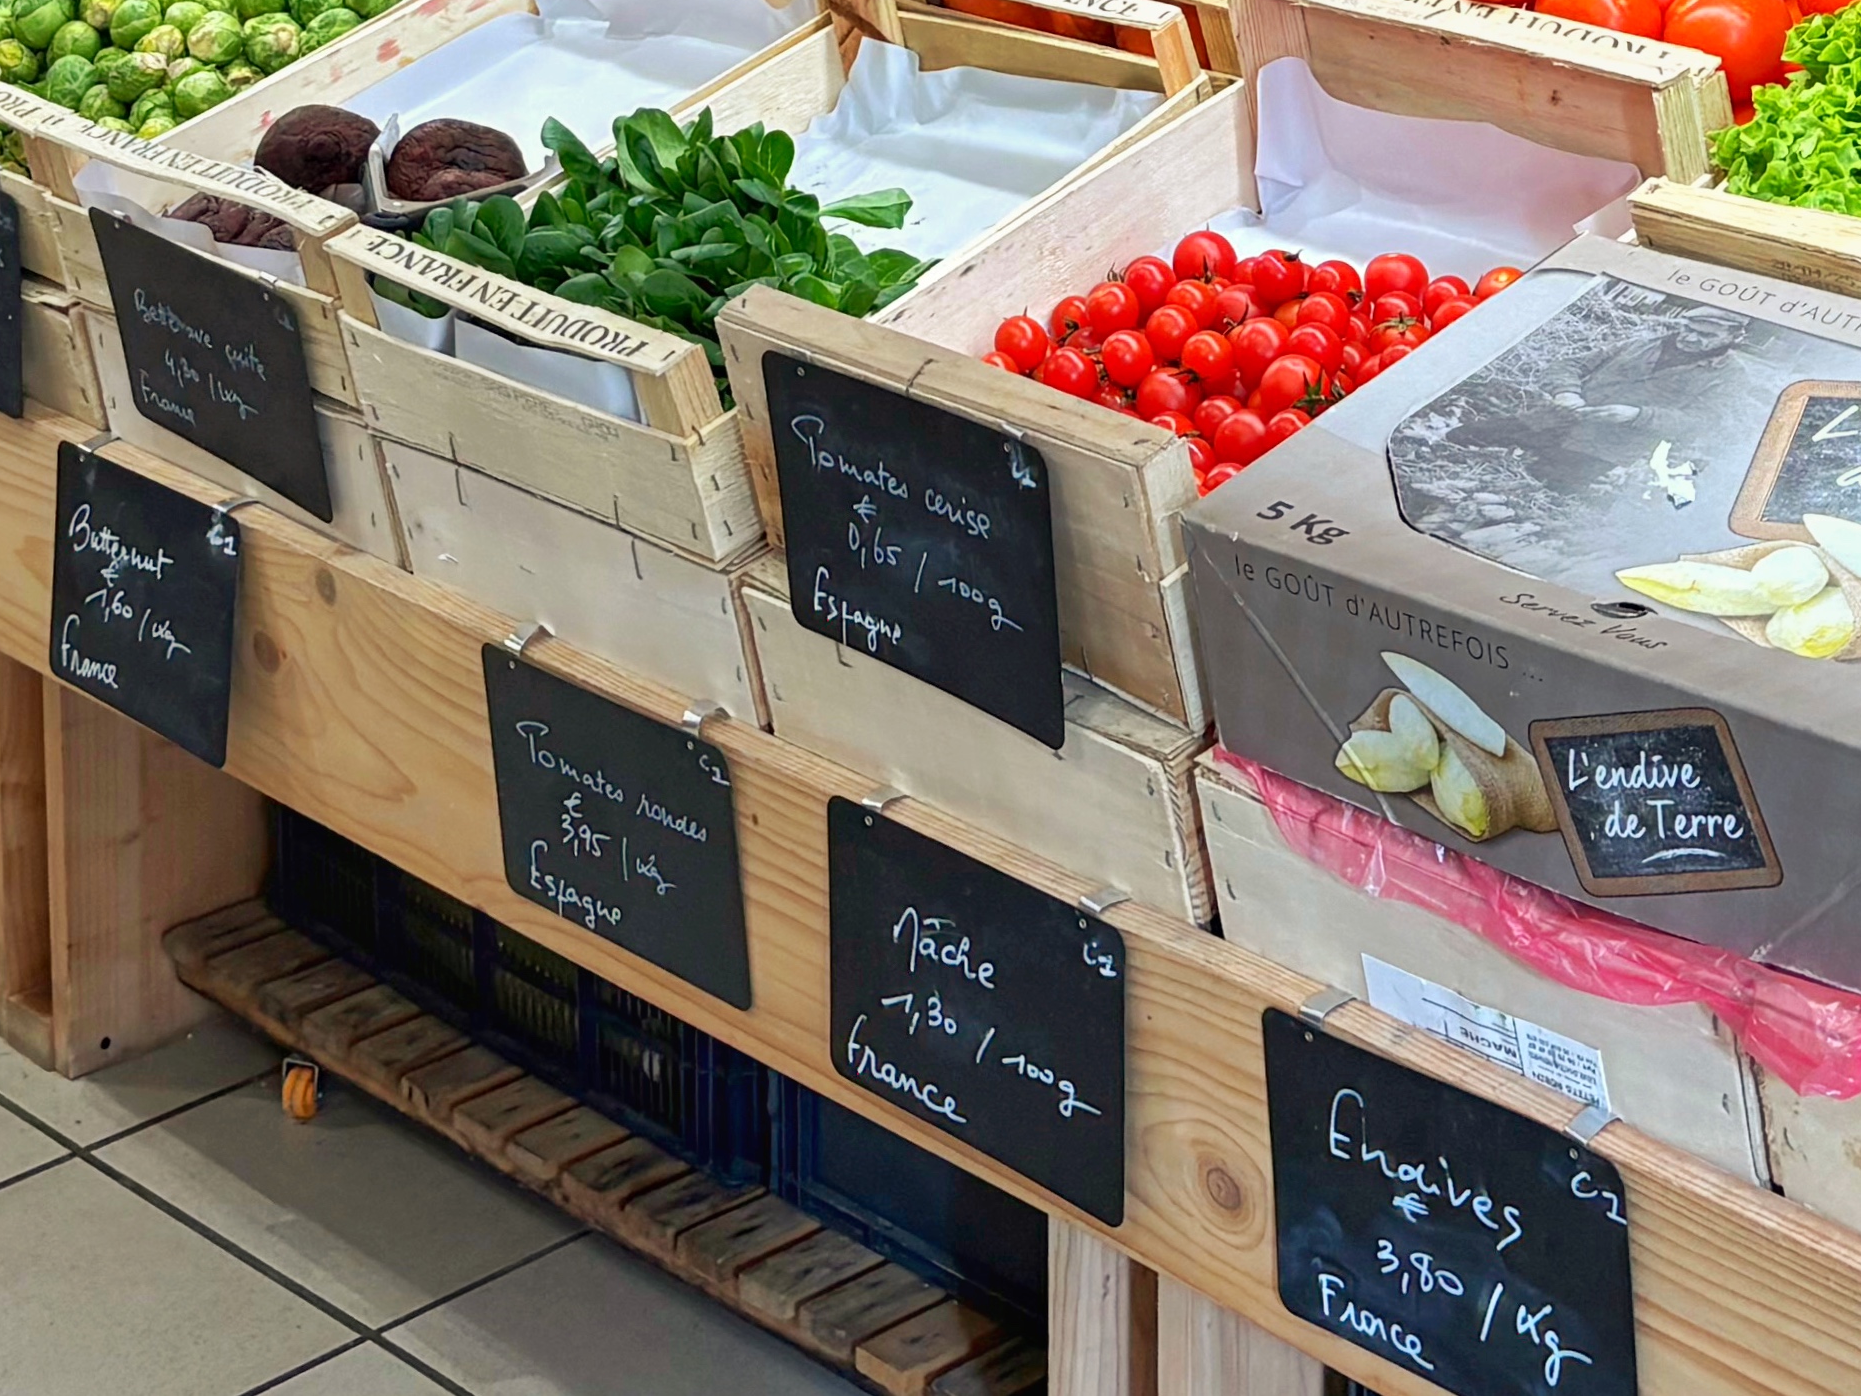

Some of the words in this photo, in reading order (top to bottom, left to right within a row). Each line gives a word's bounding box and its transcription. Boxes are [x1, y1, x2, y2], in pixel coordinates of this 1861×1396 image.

[367, 234, 482, 295] FRANCE
[1667, 268, 1691, 288] le
[1700, 275, 1776, 306] GOÛT
[133, 286, 215, 350] Betterave
[519, 297, 649, 359] PRODUIT
[791, 414, 909, 500] Tomates
[925, 487, 993, 541] cerise
[853, 494, 878, 524] €
[68, 503, 175, 580] Butternut
[847, 521, 902, 570] 0,65
[1255, 500, 1296, 522] 5
[1289, 510, 1352, 548] Kg
[83, 588, 134, 624] 1,60
[813, 565, 903, 653] Espagne
[1234, 553, 1256, 584] le
[1264, 564, 1335, 611] GOÛT
[1345, 592, 1510, 673] d'AUTREFOIS
[1499, 589, 1590, 630] Servez
[1598, 617, 1670, 653] Vous
[60, 613, 120, 690] France
[516, 721, 625, 803] Tomates
[636, 793, 709, 843] rondes
[1567, 747, 1701, 793] L'endive
[560, 813, 612, 859] 3,95
[563, 792, 583, 819] €
[1604, 806, 1647, 840] de
[1646, 799, 1746, 841] Terre
[530, 840, 623, 930] Espagne
[893, 905, 996, 990] Mâche
[847, 1014, 968, 1125] France
[881, 991, 958, 1036] 1,30
[1001, 1054, 1103, 1118] 100g
[1327, 1087, 1525, 1252] Endives
[1376, 1238, 1465, 1297] 3,80
[1317, 1272, 1436, 1371] France
